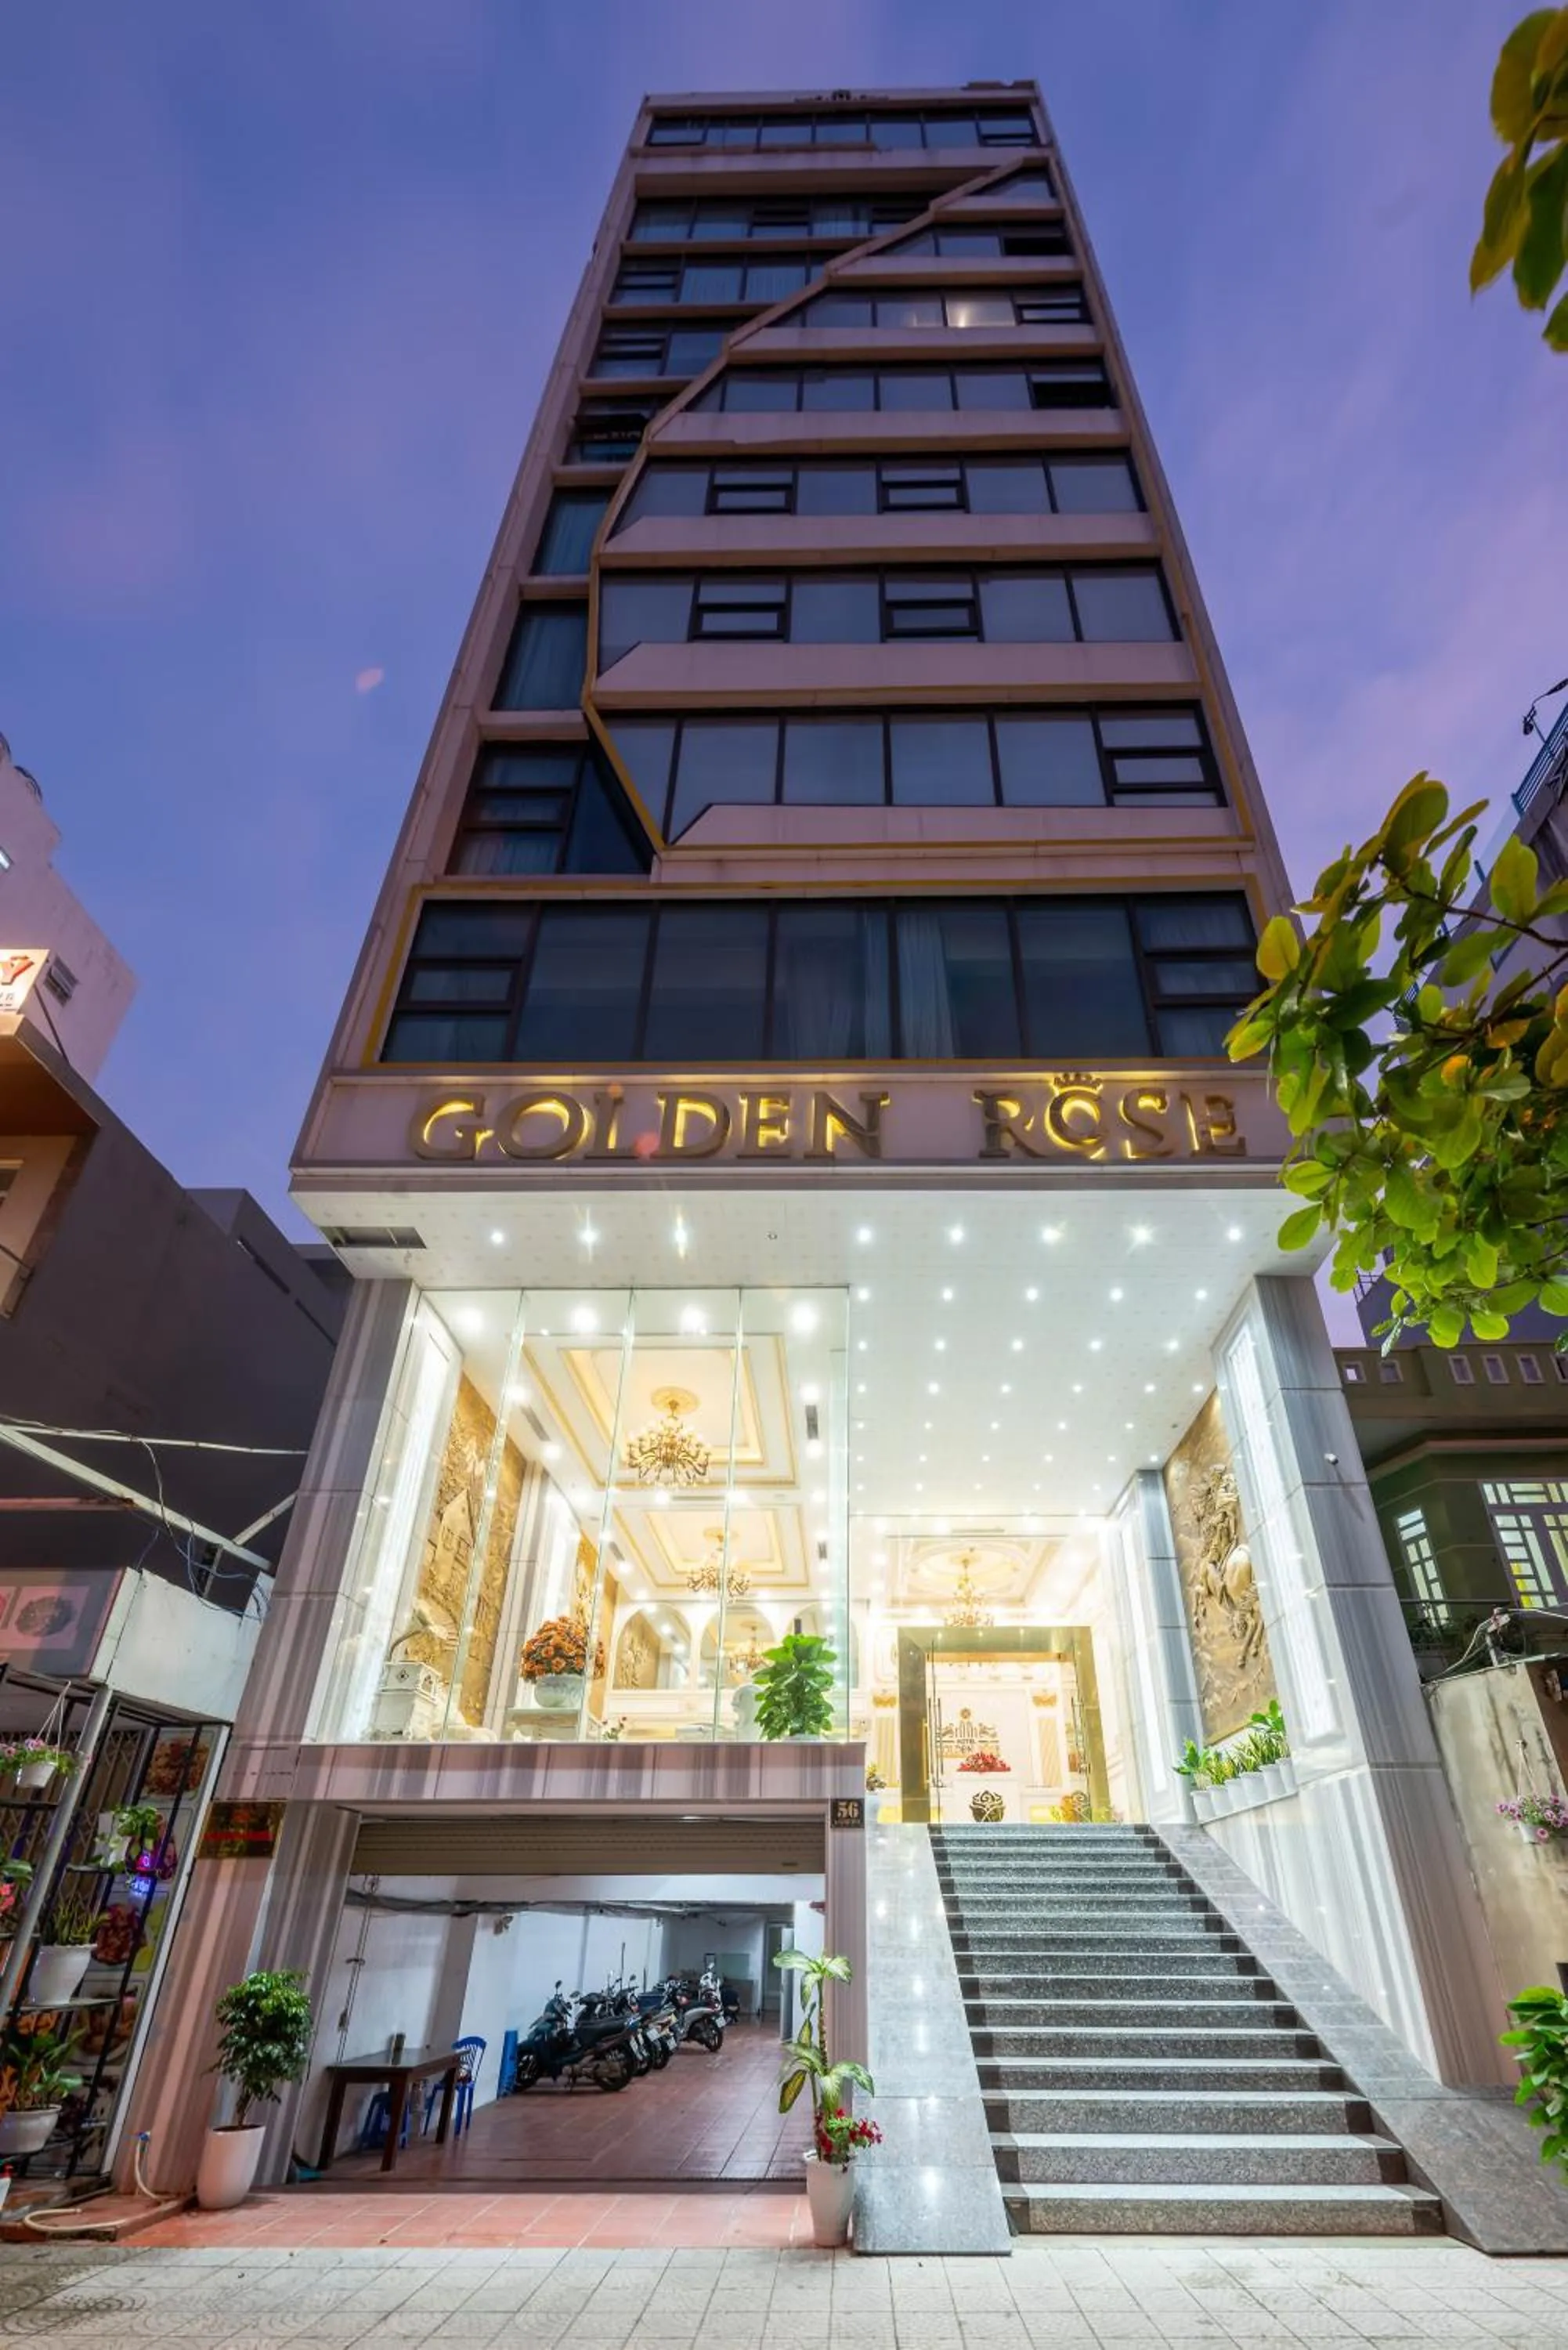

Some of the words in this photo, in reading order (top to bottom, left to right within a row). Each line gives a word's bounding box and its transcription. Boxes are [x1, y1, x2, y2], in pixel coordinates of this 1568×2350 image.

[408, 1090, 890, 1159] GOLDEN
[974, 1087, 1246, 1159] ROSE
[838, 1802, 858, 1818] 56
